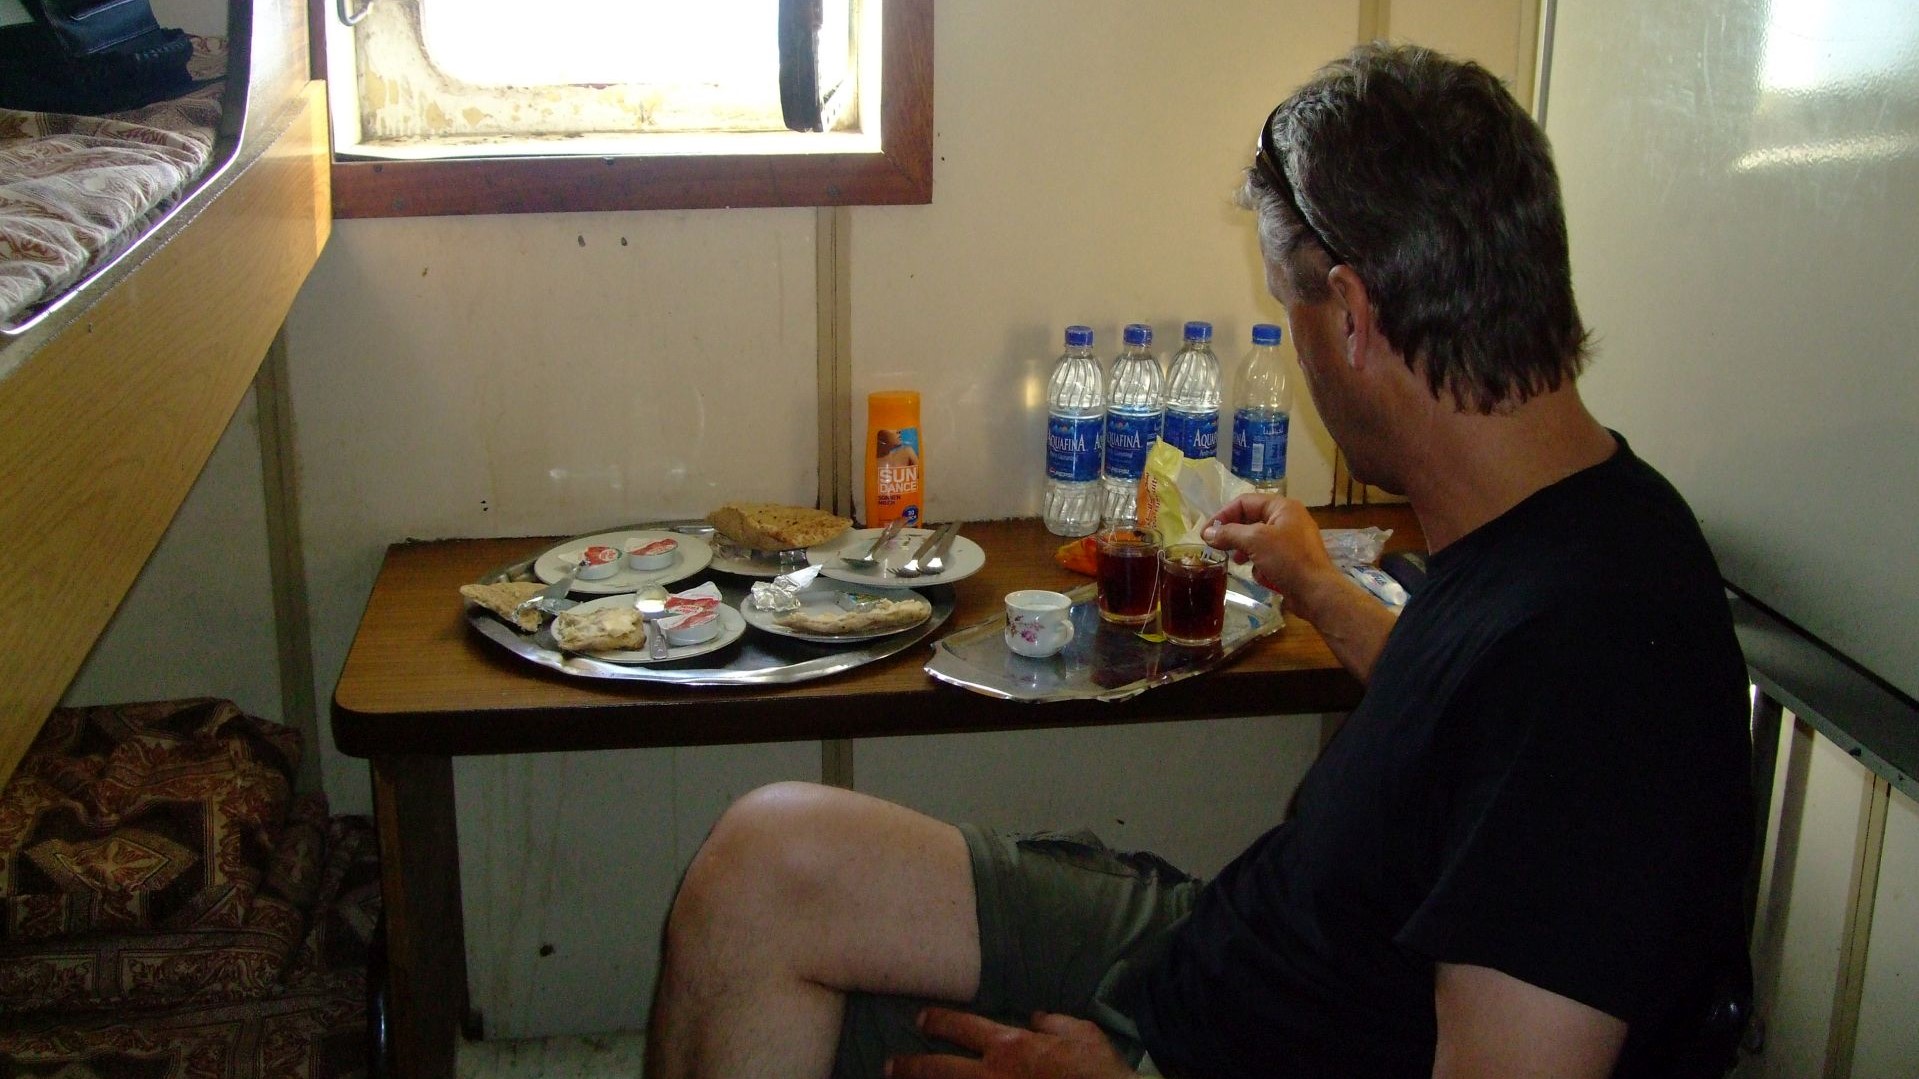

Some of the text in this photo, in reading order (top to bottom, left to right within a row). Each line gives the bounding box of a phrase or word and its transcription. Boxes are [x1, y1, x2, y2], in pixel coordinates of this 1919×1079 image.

[1107, 430, 1140, 448] QUAFINA
[879, 467, 917, 482] SUN
[879, 481, 917, 493] DANCE
